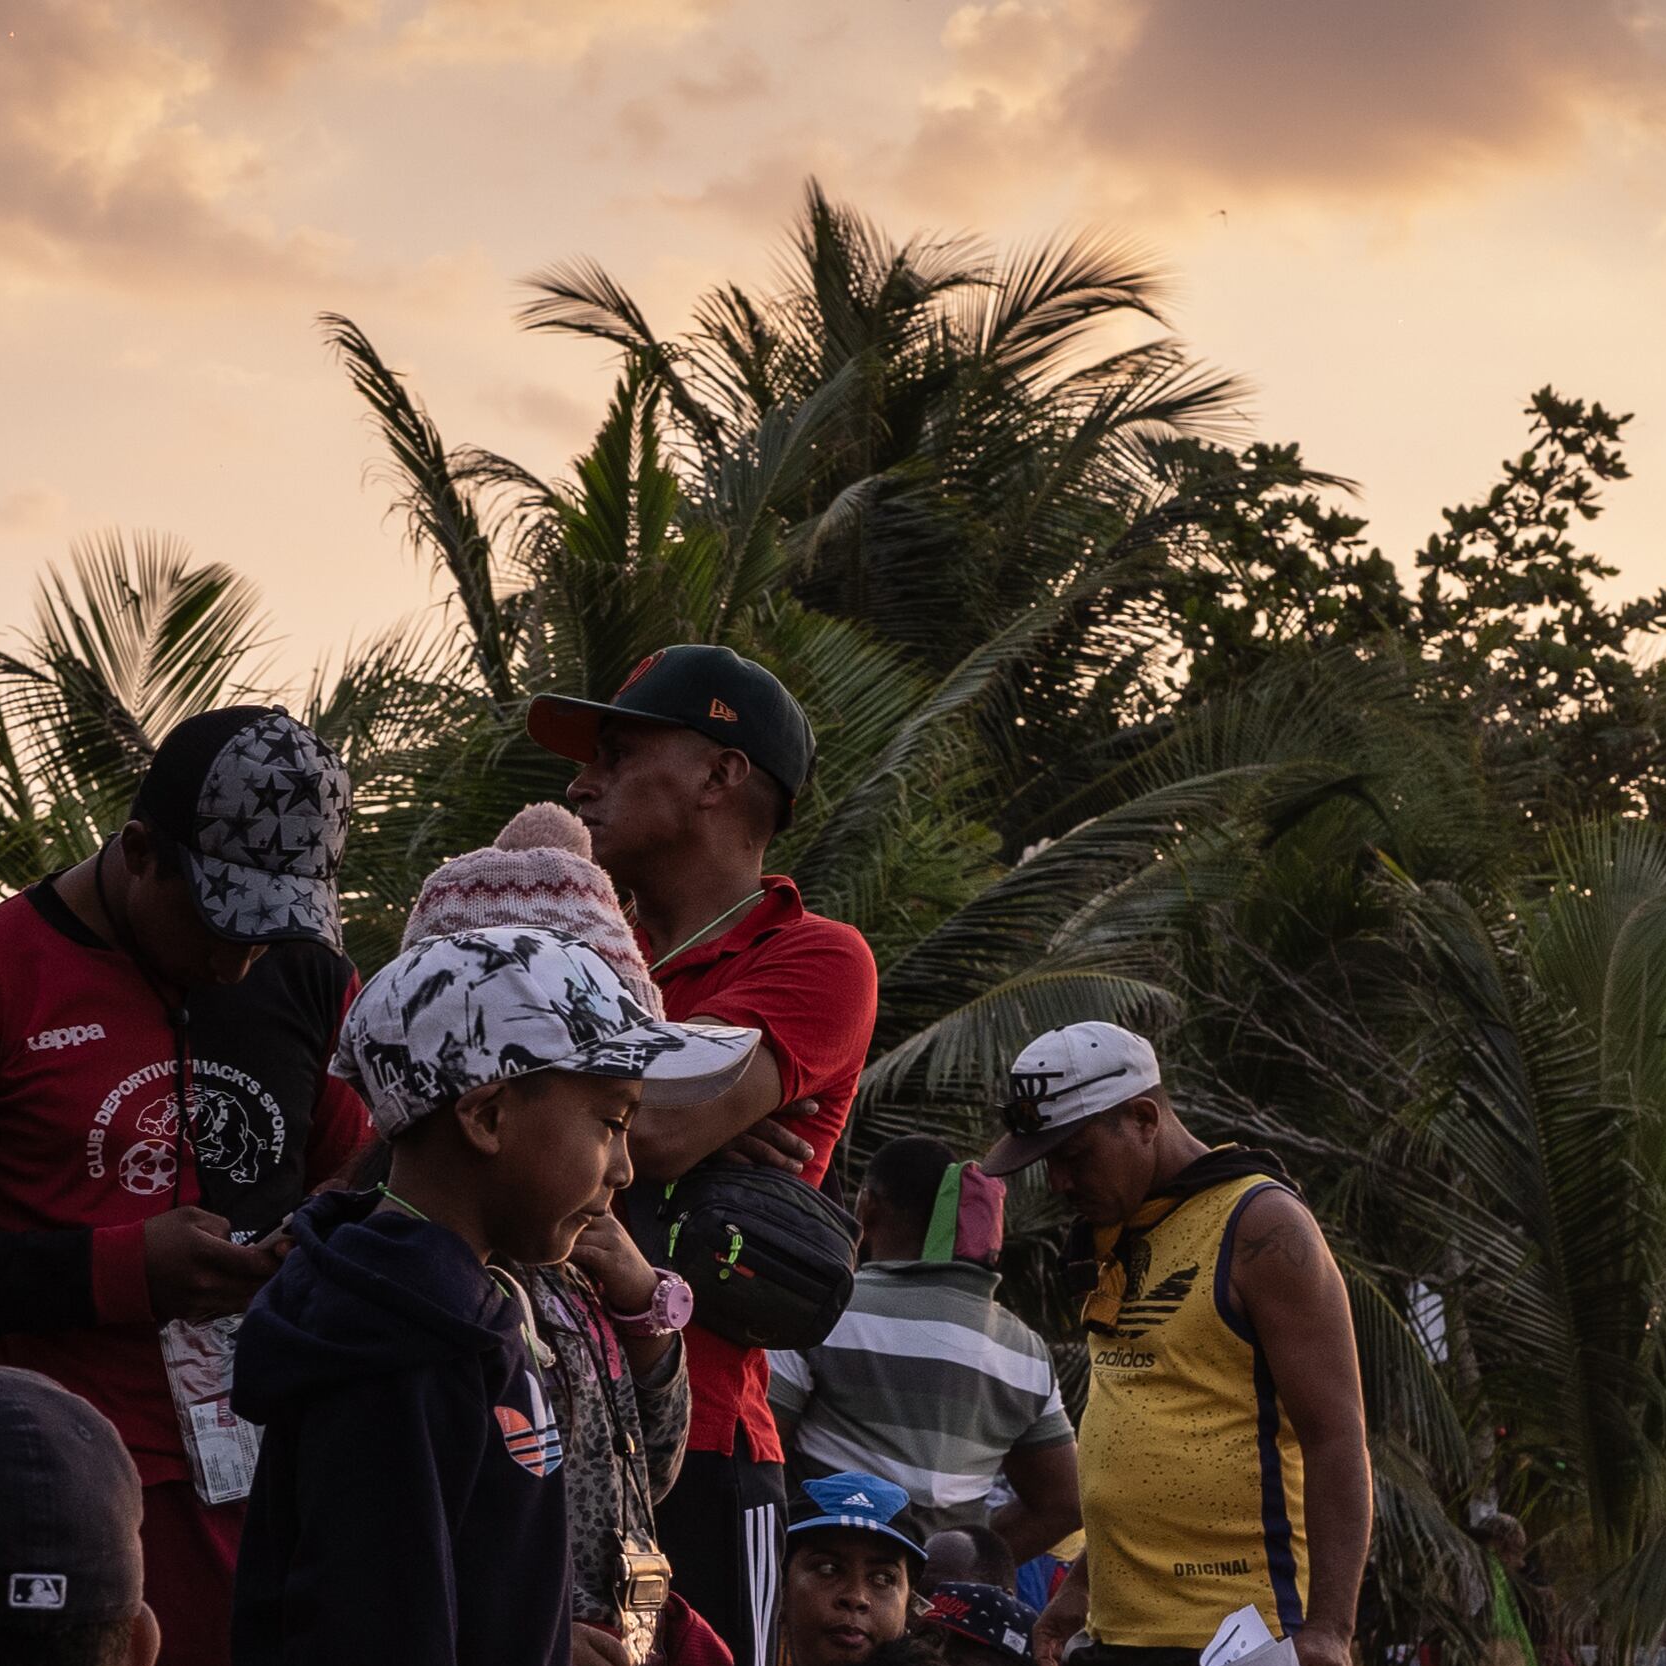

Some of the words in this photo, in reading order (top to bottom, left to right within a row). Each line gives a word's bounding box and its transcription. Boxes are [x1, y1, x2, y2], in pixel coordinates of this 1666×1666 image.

[94, 1059, 180, 1127] DEPORTIVO
[87, 1128, 107, 1179] CLUB
[1094, 1345, 1156, 1368] adidas
[1173, 1558, 1252, 1577] ORIGINAL
